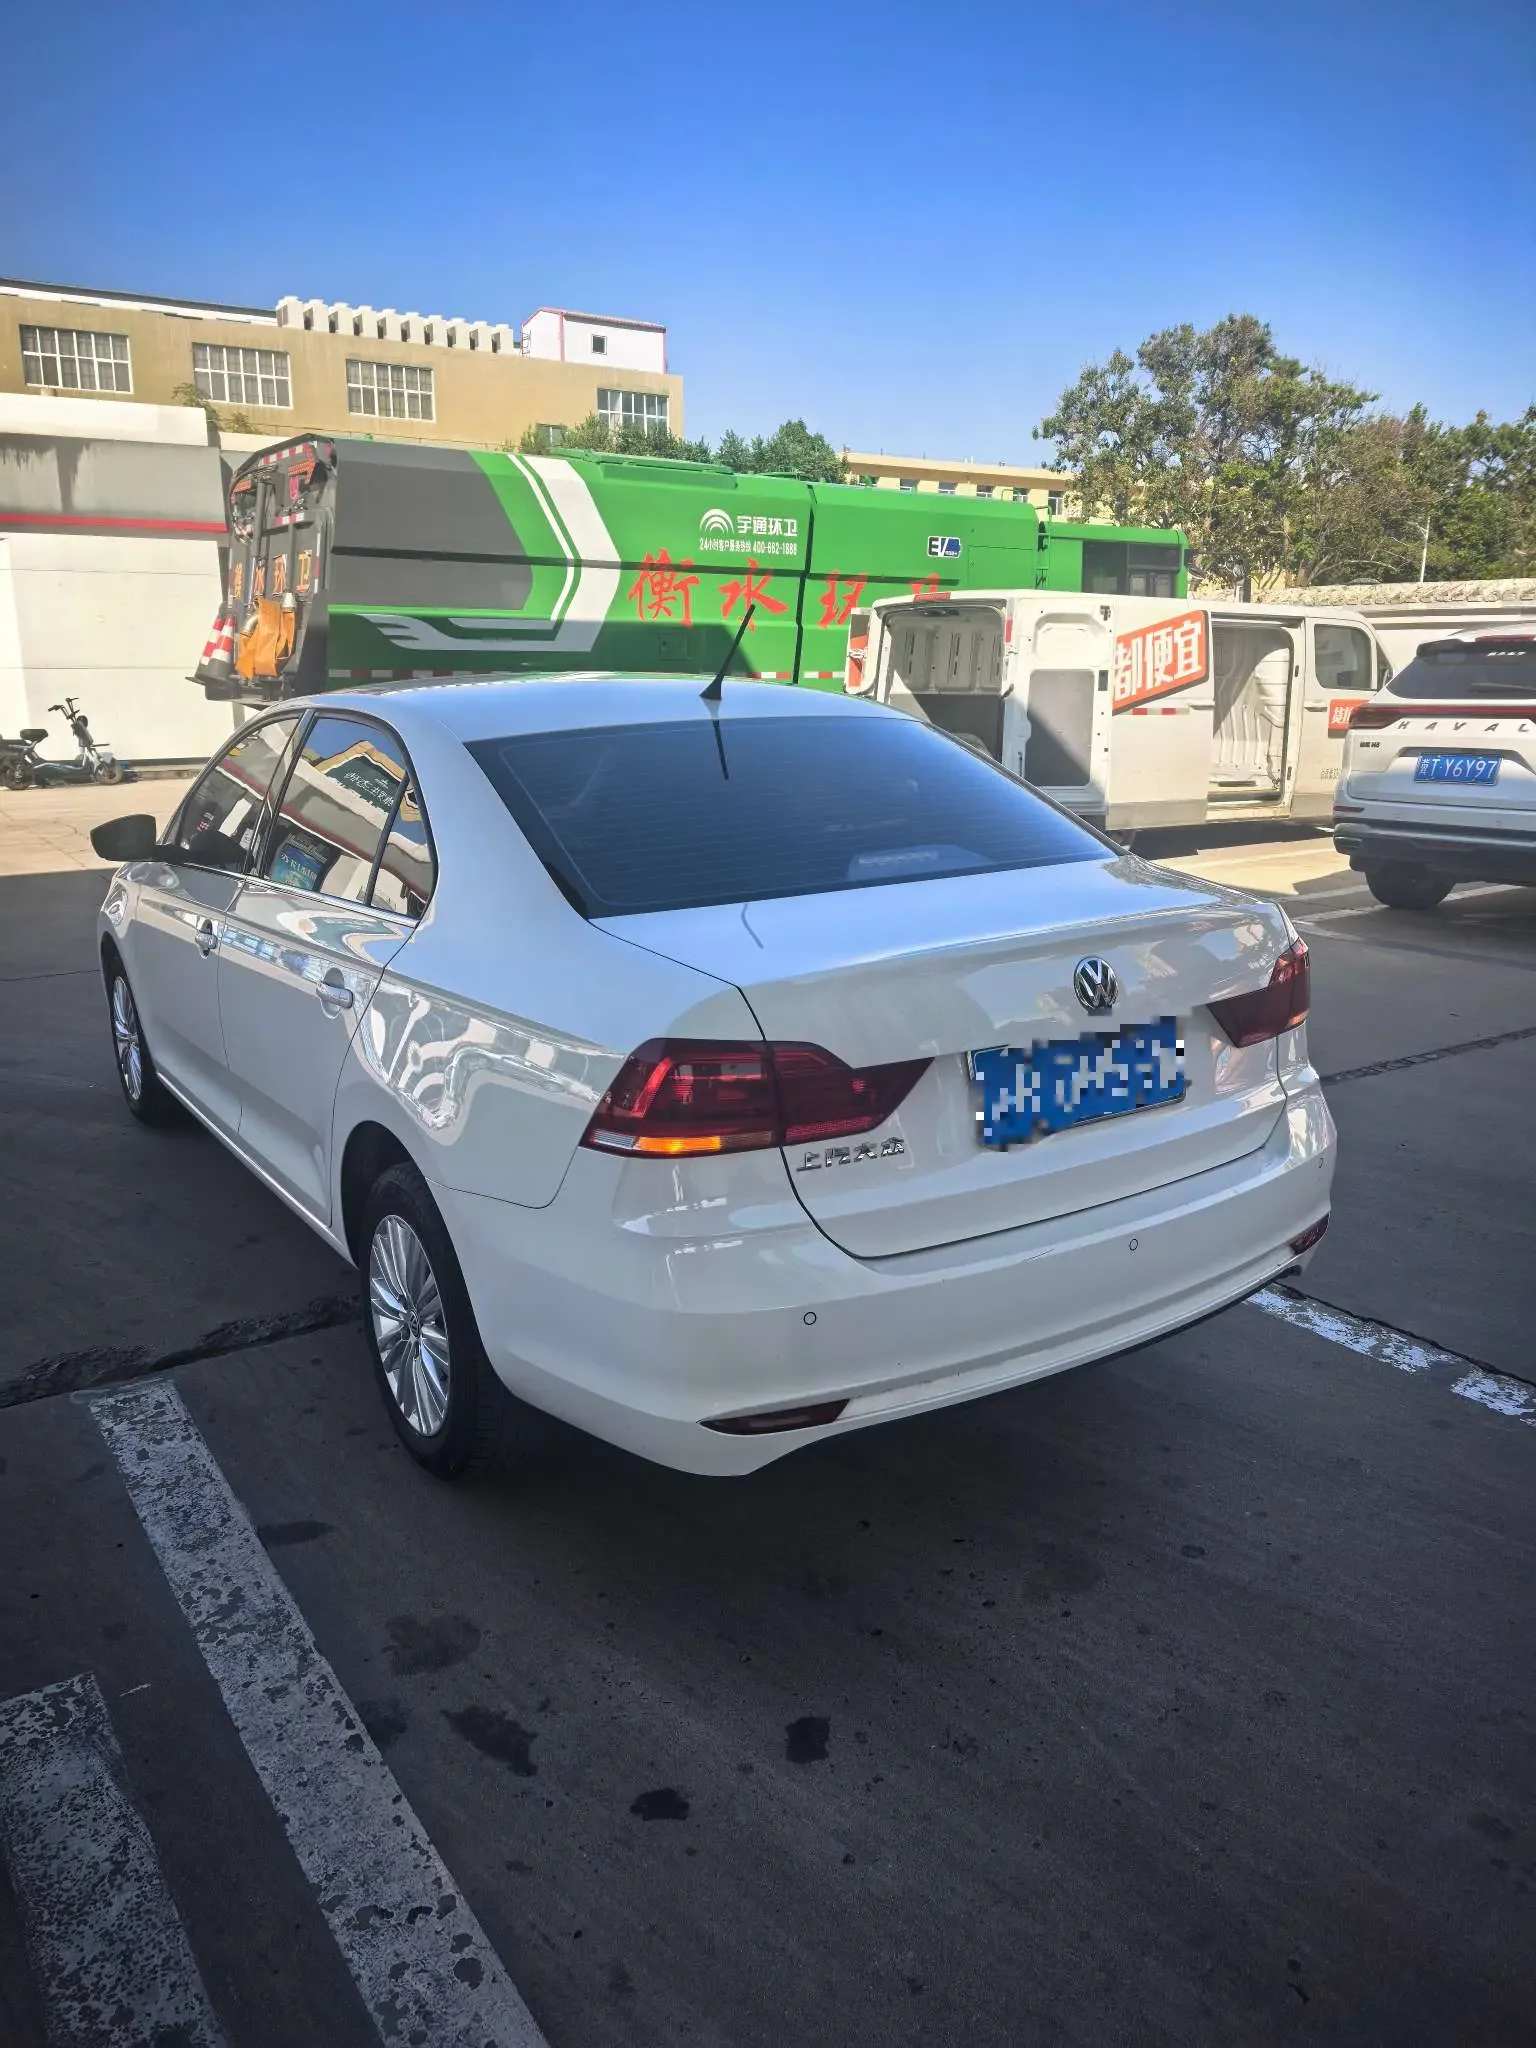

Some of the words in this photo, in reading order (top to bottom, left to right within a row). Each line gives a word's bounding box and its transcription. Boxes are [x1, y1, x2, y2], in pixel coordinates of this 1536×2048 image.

[736, 515, 798, 537] 宇通环卫
[628, 548, 940, 632] 衡水环
[1113, 620, 1203, 701] 都便宜
[1397, 720, 1530, 733] HAVAL
